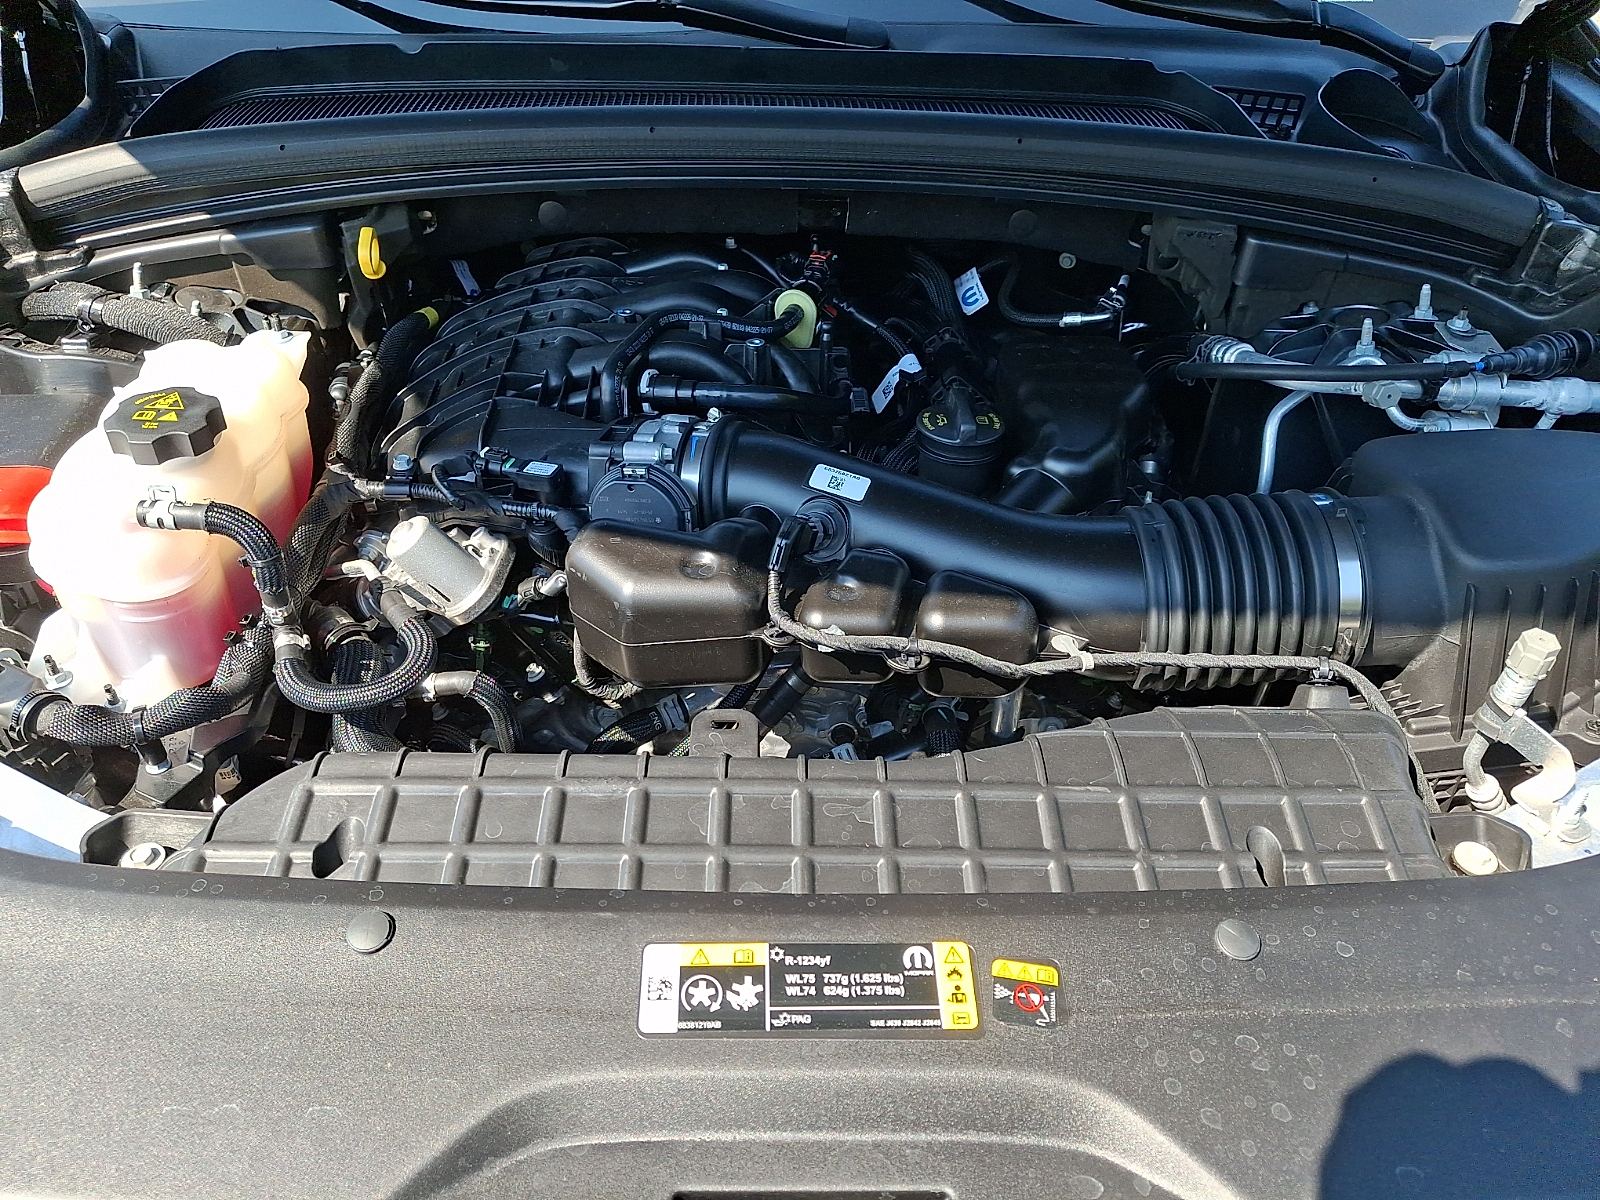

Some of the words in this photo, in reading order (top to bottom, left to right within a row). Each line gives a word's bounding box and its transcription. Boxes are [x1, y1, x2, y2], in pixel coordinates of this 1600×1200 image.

[648, 711, 662, 730] ENG
[784, 955, 832, 968] R-1234yf
[785, 973, 816, 984] WL75
[823, 974, 849, 986] 737g
[850, 973, 882, 985] (1.625
[884, 973, 905, 985] lbs)
[785, 986, 816, 996] WL74
[823, 986, 850, 998] 624g
[851, 986, 883, 997] (1.375
[884, 986, 905, 997] lbs)
[791, 1014, 812, 1024] PAG
